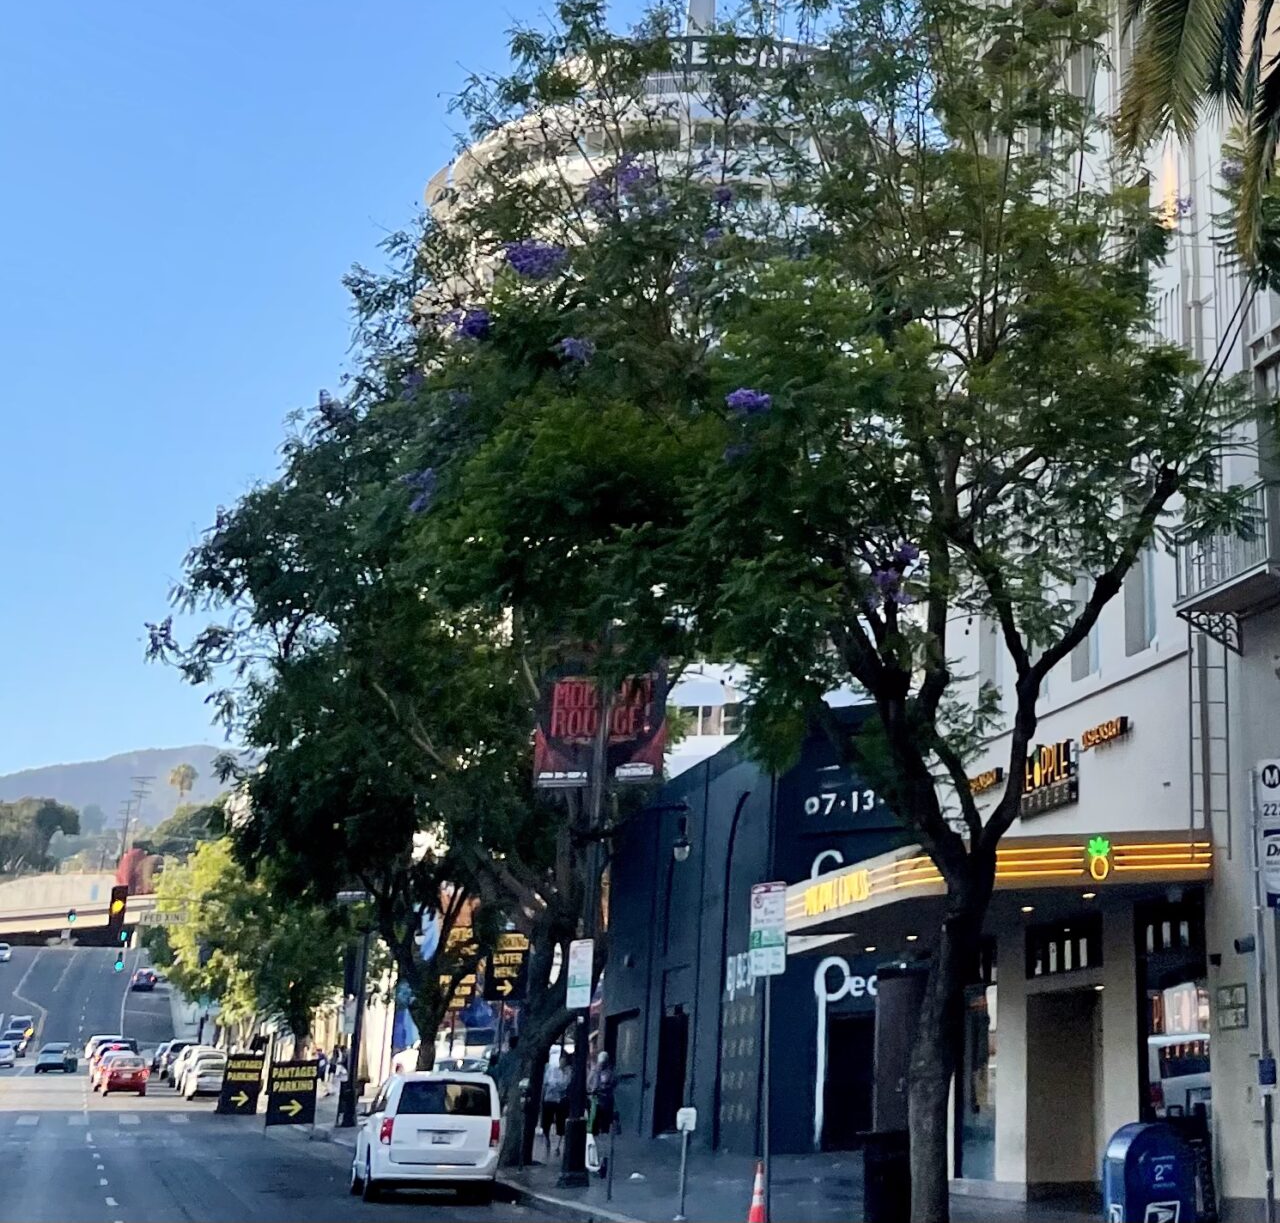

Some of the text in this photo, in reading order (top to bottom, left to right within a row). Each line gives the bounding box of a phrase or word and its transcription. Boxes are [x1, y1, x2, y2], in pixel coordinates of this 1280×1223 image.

[228, 1059, 264, 1069] PANTAGES
[227, 1072, 260, 1081] PARKING
[272, 1066, 317, 1078] PANTAGES
[272, 1080, 314, 1092] PARKING
